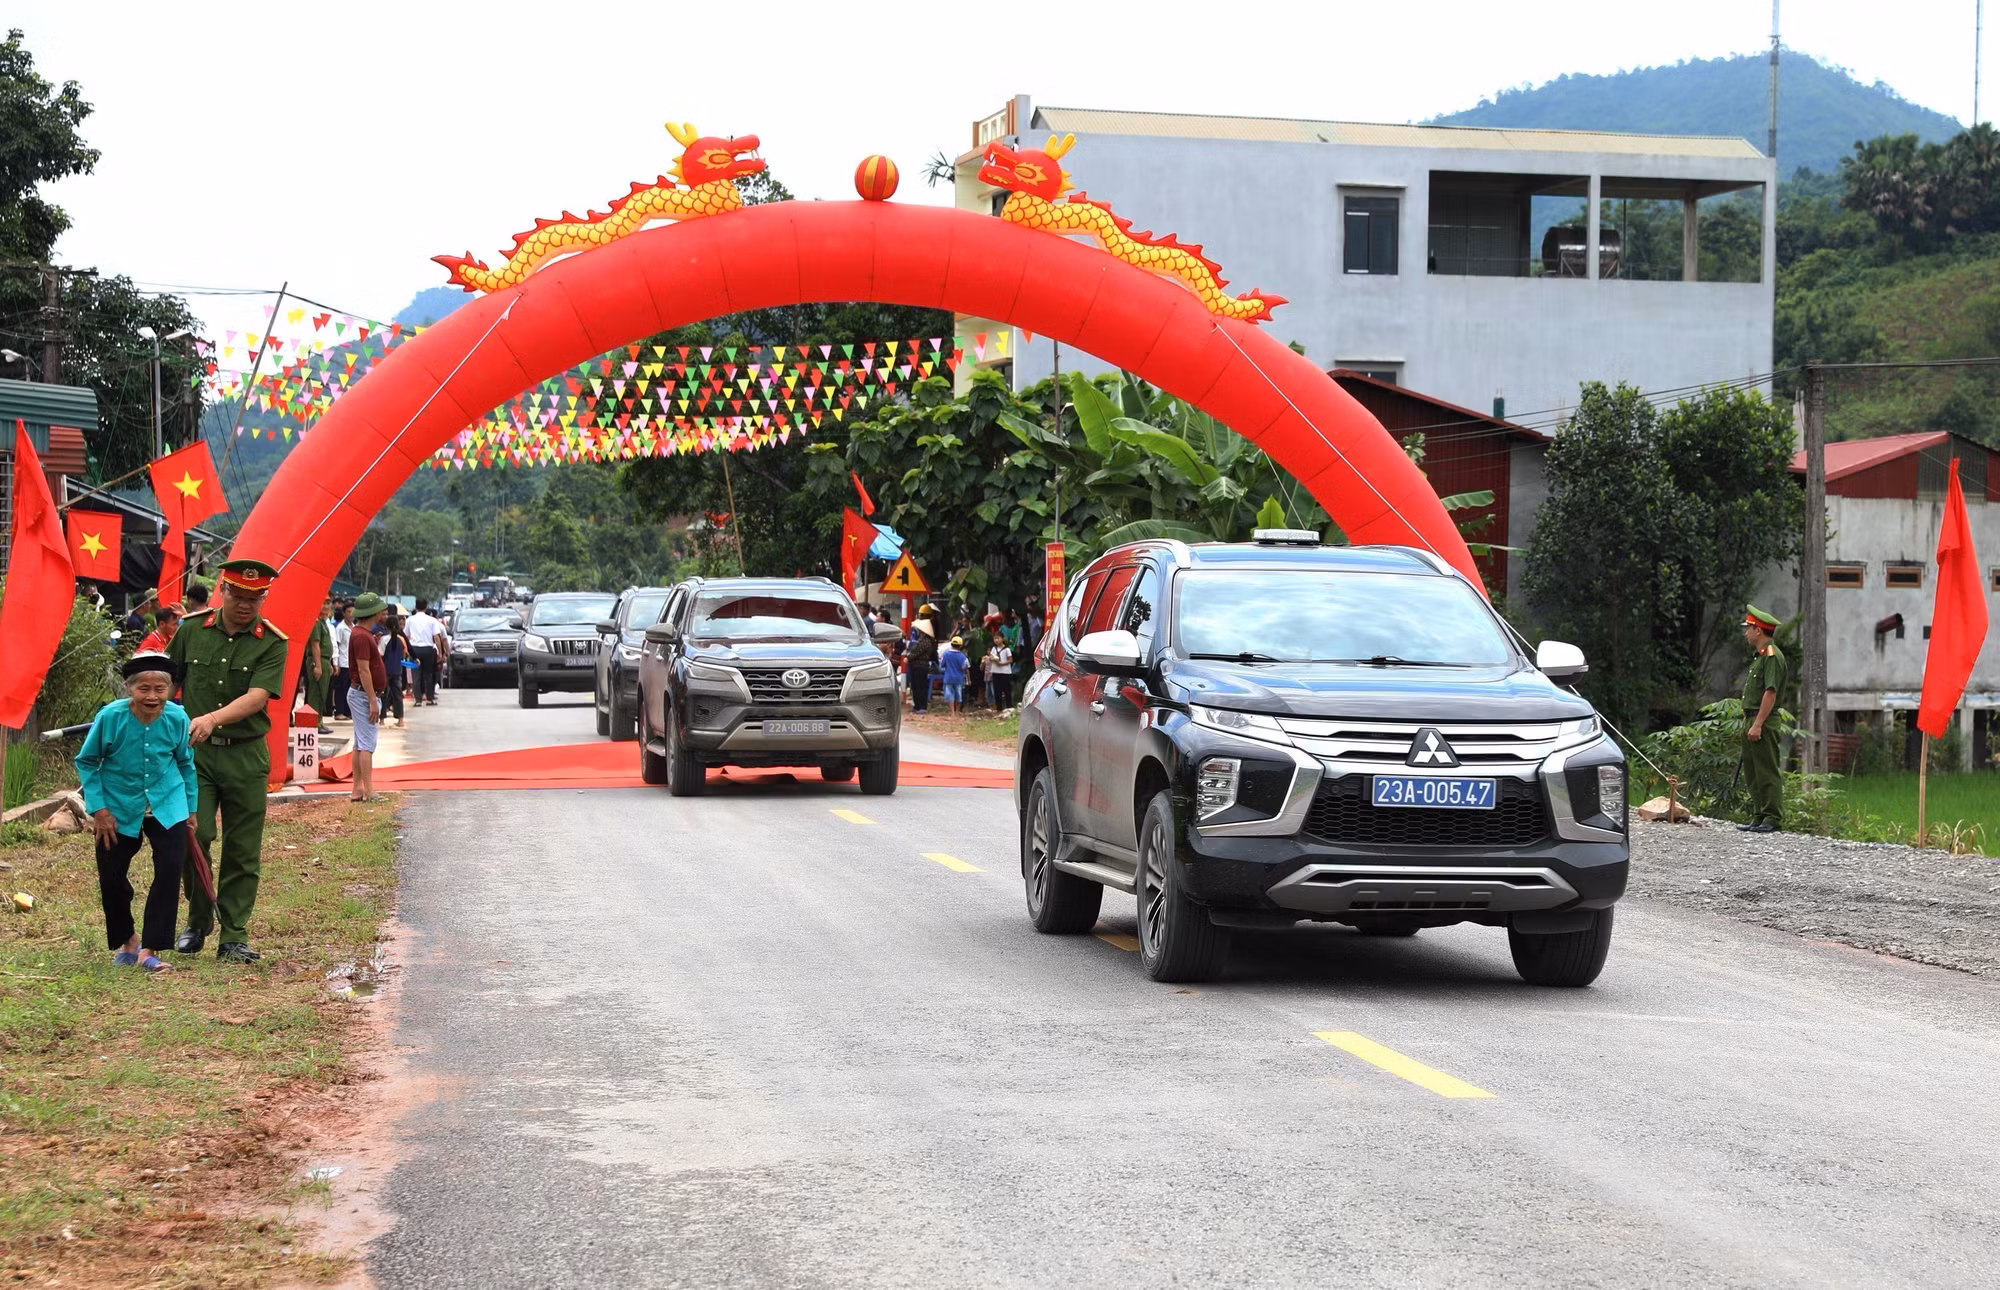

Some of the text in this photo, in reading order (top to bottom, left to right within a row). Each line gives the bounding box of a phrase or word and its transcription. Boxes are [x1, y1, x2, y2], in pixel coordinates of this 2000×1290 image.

[768, 722, 825, 733] 22A-006.88
[297, 733, 315, 747] H6
[298, 754, 313, 767] 46
[1377, 780, 1491, 805] 23A-005.47
